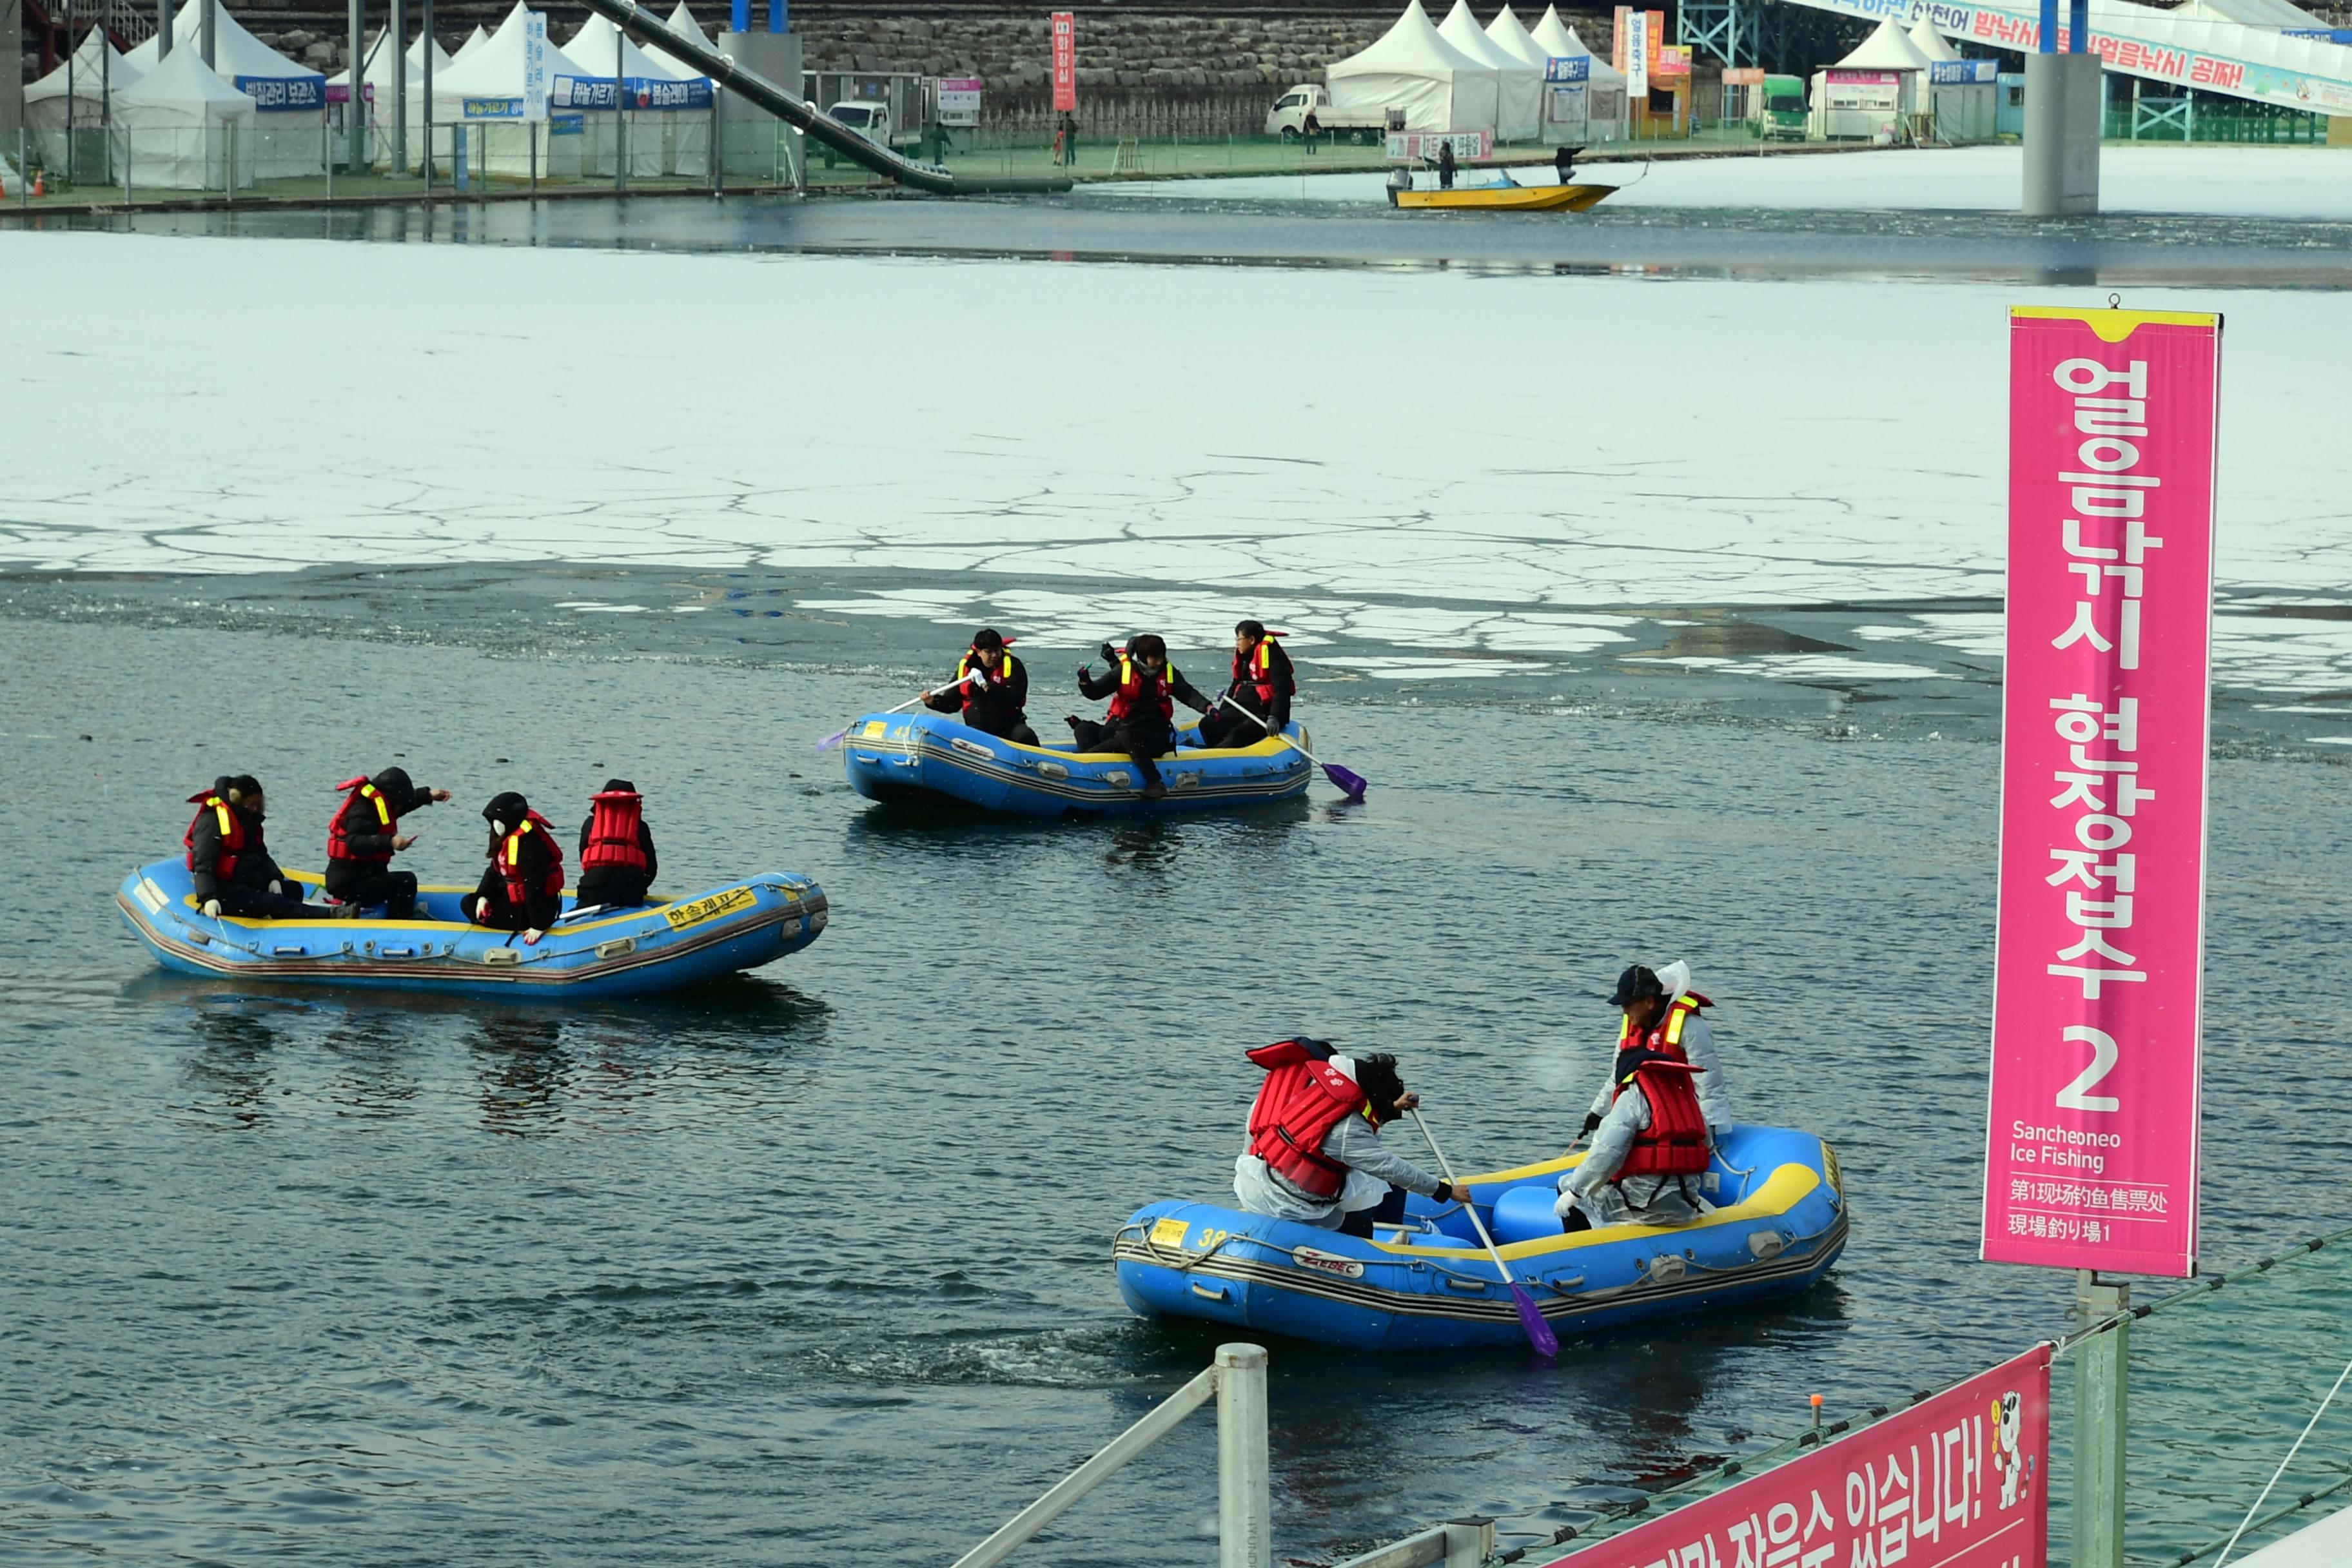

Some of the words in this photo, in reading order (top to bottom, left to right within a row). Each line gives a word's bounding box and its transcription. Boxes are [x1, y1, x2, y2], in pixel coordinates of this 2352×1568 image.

[1058, 35, 1068, 83] 화장실
[1631, 19, 1642, 77] 얼음축구
[1912, 1, 1967, 31] 산천어
[1974, 10, 2041, 47] 밤낚시
[2190, 57, 2244, 88] 공짜!
[288, 82, 316, 104] 보관소
[652, 83, 688, 105] 봅슬레이
[2051, 358, 2162, 669] 얼음낚시
[2045, 693, 2155, 999] 현장접수
[2055, 1025, 2119, 1112] 2
[2012, 1120, 2121, 1148] Sancheoneo
[2010, 1142, 2036, 1162] Ice
[2041, 1146, 2104, 1174] Fishing
[2010, 1178, 2168, 1214] 第1现场钓鱼售票处
[2007, 1213, 2110, 1243] 現場釣り場1
[1302, 1251, 1356, 1274] ZEBEC
[1847, 1415, 1982, 1568] 있습니다!
